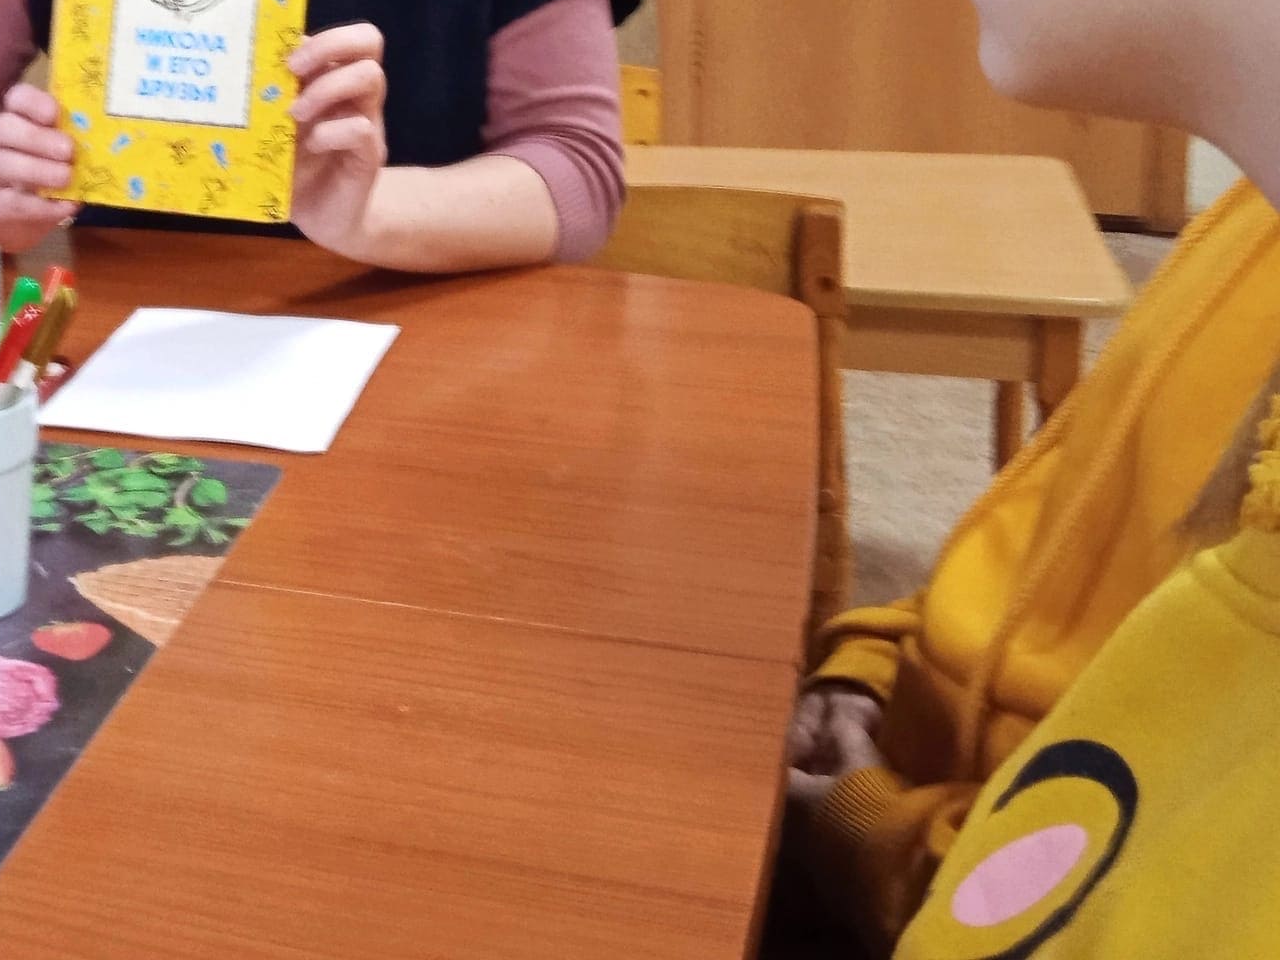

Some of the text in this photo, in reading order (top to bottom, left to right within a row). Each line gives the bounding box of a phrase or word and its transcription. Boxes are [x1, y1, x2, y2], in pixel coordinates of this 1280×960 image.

[135, 26, 227, 53] НИКОЛА
[169, 55, 211, 76] ЕГО
[136, 77, 217, 103] ДРУЗЬЯ
